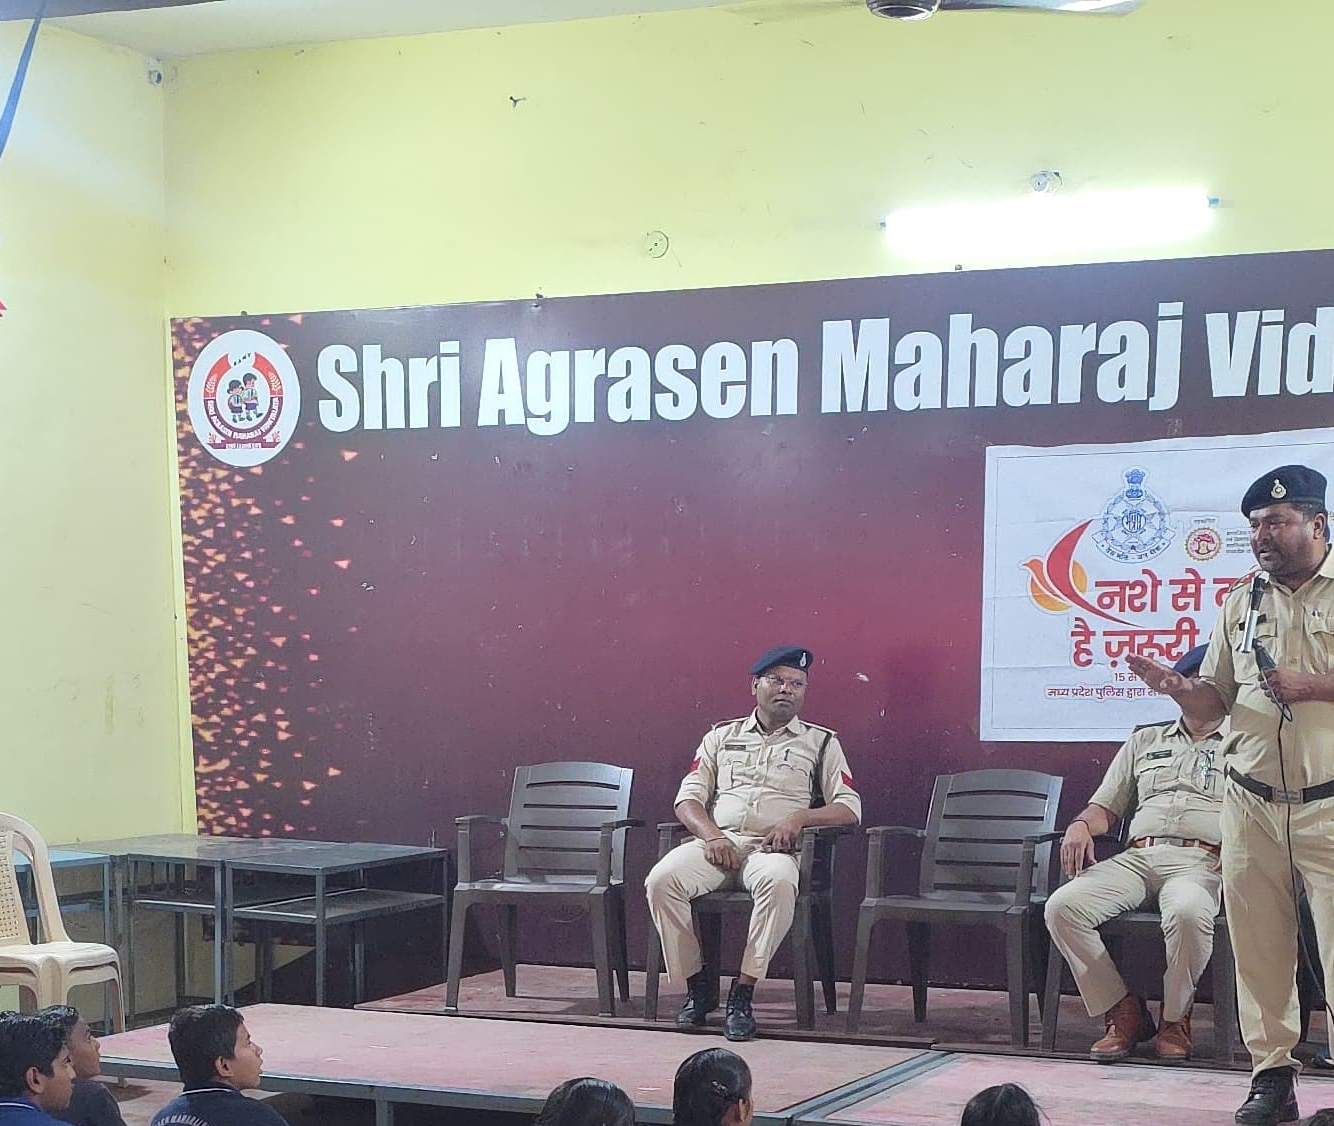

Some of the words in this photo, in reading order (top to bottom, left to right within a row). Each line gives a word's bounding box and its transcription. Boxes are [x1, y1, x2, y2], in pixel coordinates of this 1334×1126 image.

[317, 339, 461, 432] Shri
[478, 337, 799, 435] Agrasen
[821, 302, 1184, 413] Maharaj
[1095, 568, 1162, 612] नशे
[1169, 568, 1205, 611] से
[1071, 616, 1096, 667] है
[1071, 685, 1093, 697] प्रदेश
[1096, 685, 1124, 699] पुलिस
[1114, 672, 1125, 682] 15
